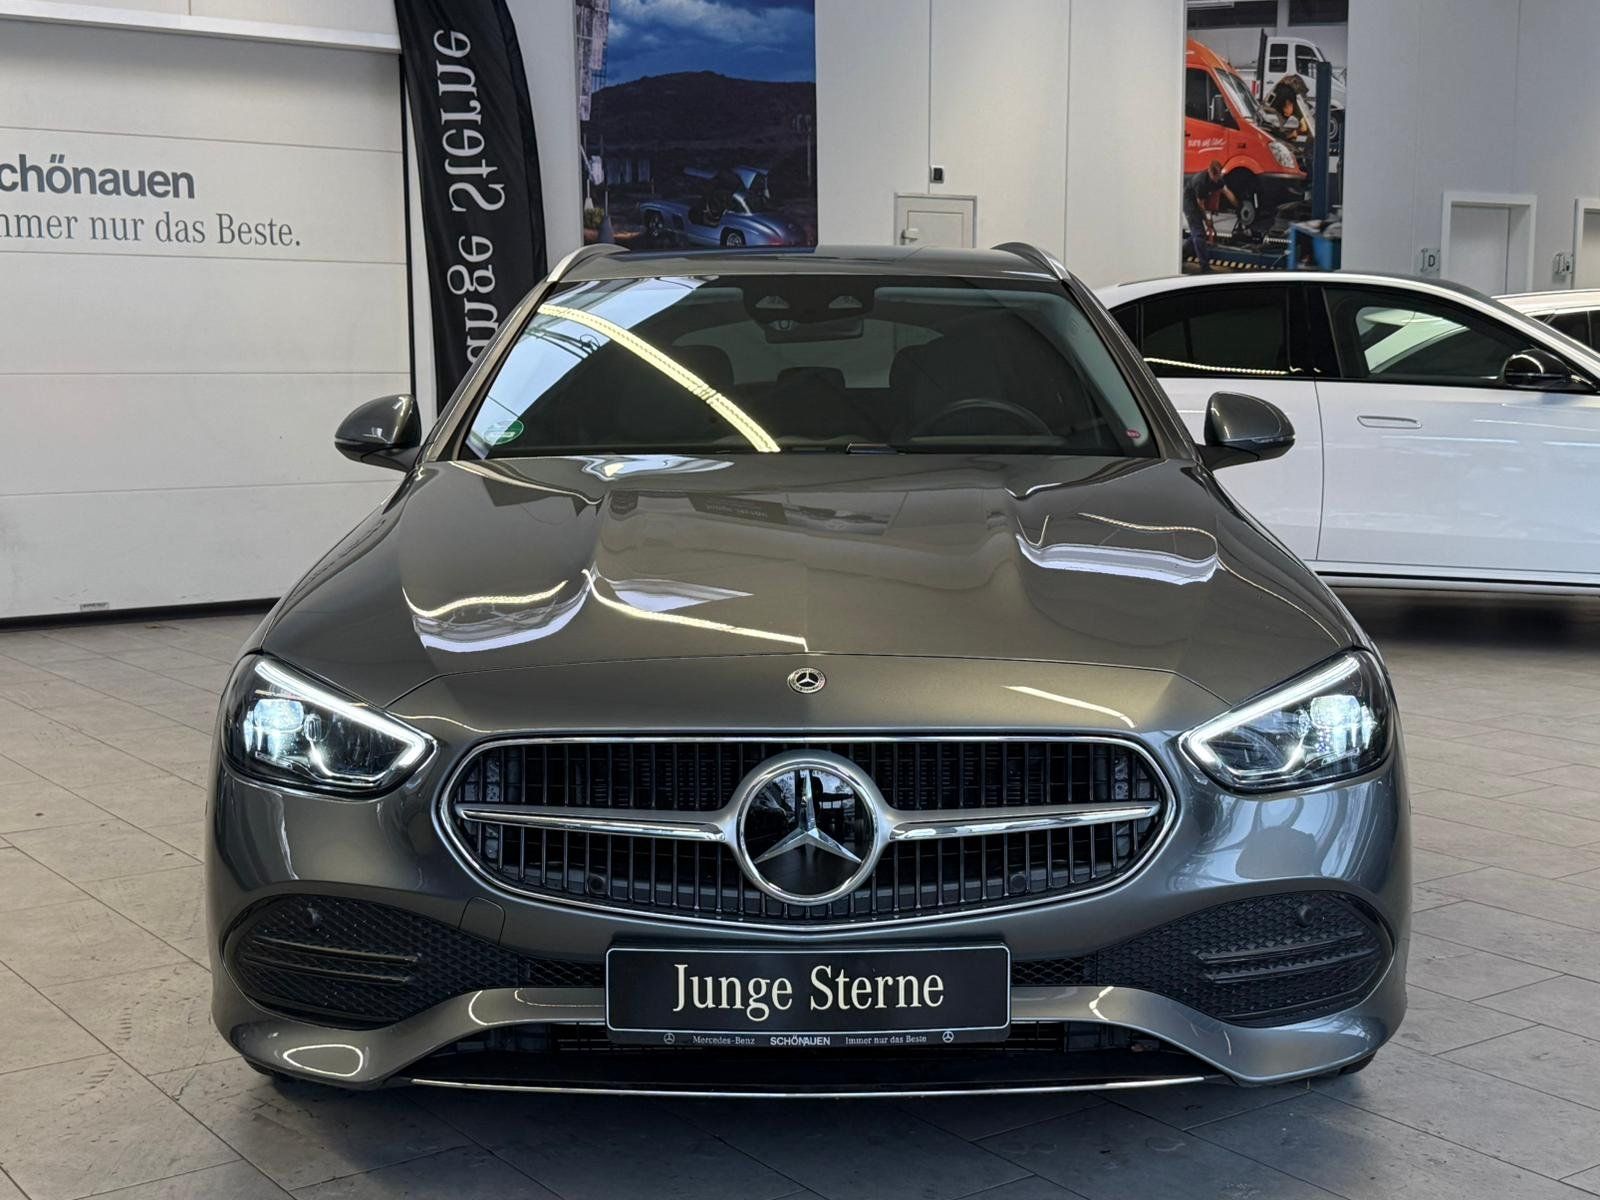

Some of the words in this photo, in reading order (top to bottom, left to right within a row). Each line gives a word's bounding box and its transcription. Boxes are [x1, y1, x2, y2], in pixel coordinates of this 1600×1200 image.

[88, 215, 145, 242] nur
[155, 211, 206, 244] das
[216, 212, 301, 247] Beste.
[672, 963, 793, 1022] Junge
[809, 965, 944, 1010] Sterne
[692, 1036, 756, 1045] Mercedes-Benz
[769, 1035, 831, 1046] SCHÖNAUEN
[845, 1036, 872, 1045] Immer
[874, 1036, 888, 1044] nur
[889, 1035, 904, 1044] das
[905, 1034, 927, 1043] Beste
